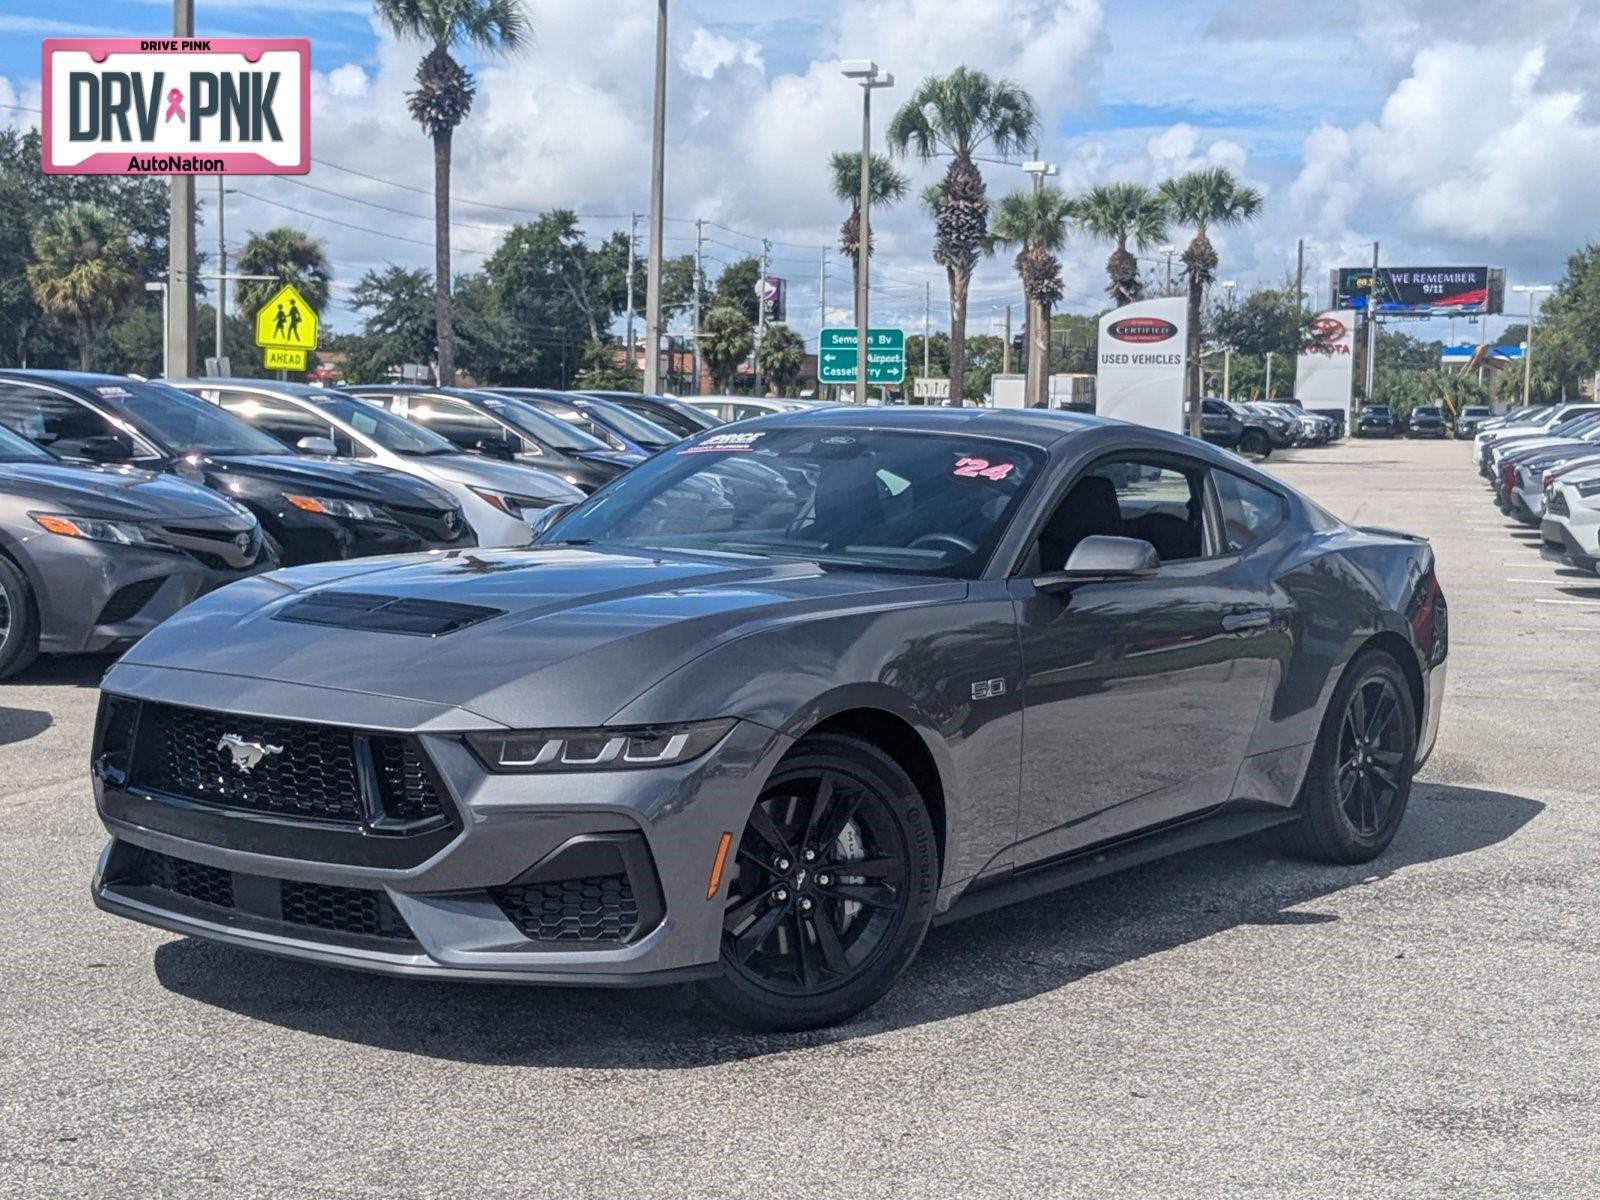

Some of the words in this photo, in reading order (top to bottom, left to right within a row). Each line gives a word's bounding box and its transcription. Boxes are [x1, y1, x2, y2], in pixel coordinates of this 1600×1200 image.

[1391, 273, 1409, 284] WE
[1413, 273, 1476, 284] REMEMBER
[1422, 284, 1444, 294] 9/11
[878, 335, 893, 344] Bv
[270, 353, 302, 365] AHEAD
[867, 354, 900, 364] Airport
[1101, 354, 1128, 365] USED
[1131, 354, 1181, 365] VEHICLES
